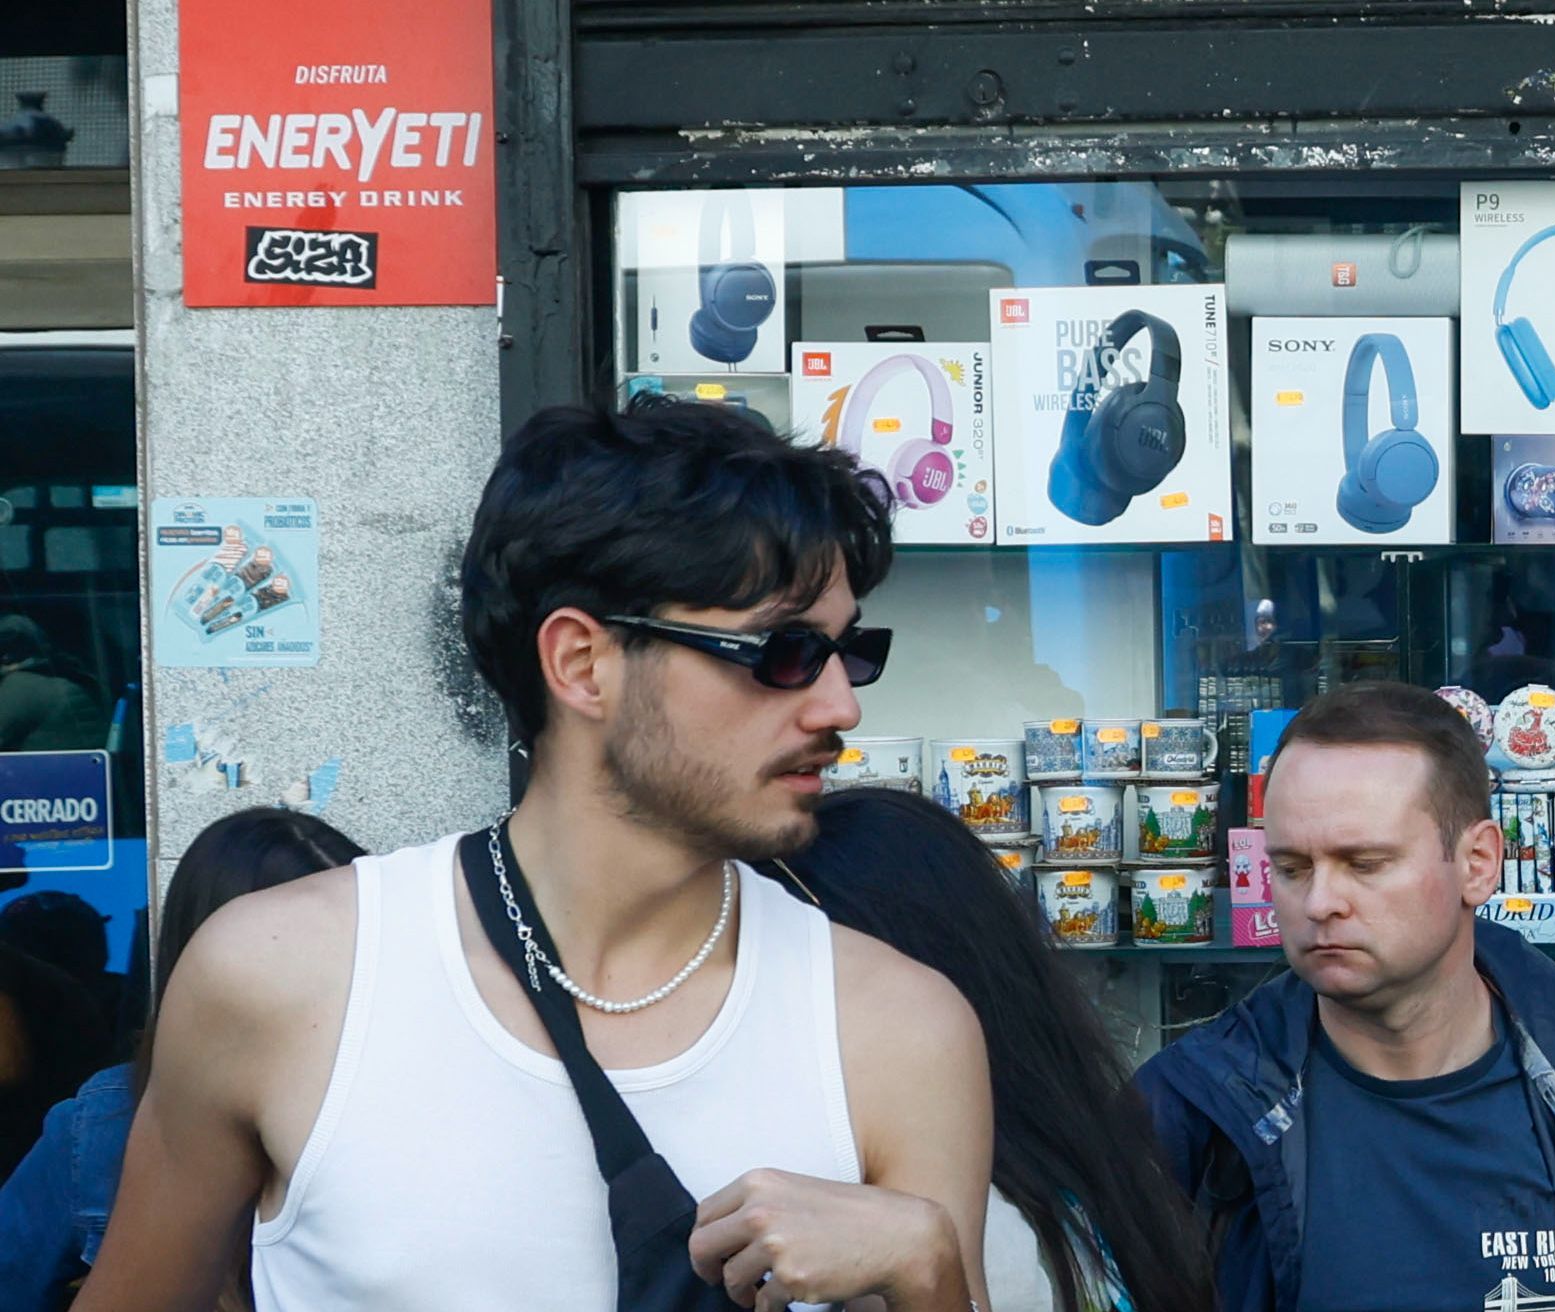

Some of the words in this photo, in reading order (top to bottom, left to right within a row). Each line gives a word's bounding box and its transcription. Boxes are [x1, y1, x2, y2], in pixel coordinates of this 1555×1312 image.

[295, 65, 388, 84] DISFRUTA
[203, 107, 482, 183] ENERYETI
[223, 191, 347, 208] ENERGY
[360, 190, 464, 207] DRINK
[1475, 193, 1500, 210] P9
[1474, 213, 1525, 223] WIRELESS
[1005, 305, 1025, 317] JBL
[1205, 295, 1216, 328] TUNE
[1055, 320, 1114, 347] PURE
[1267, 340, 1335, 352] SONY
[807, 358, 828, 371] JBL
[1056, 349, 1142, 392] BASS
[973, 352, 984, 415] JUNIOR
[1034, 392, 1102, 411] WIRELESS
[1138, 424, 1169, 451] JBL
[922, 467, 948, 491] JBL
[1015, 527, 1045, 535] Bluetooth
[245, 626, 265, 639] SIN
[0, 797, 98, 824] CERRADO
[1481, 1231, 1529, 1259] EAST
[1501, 1255, 1529, 1270] NEW
